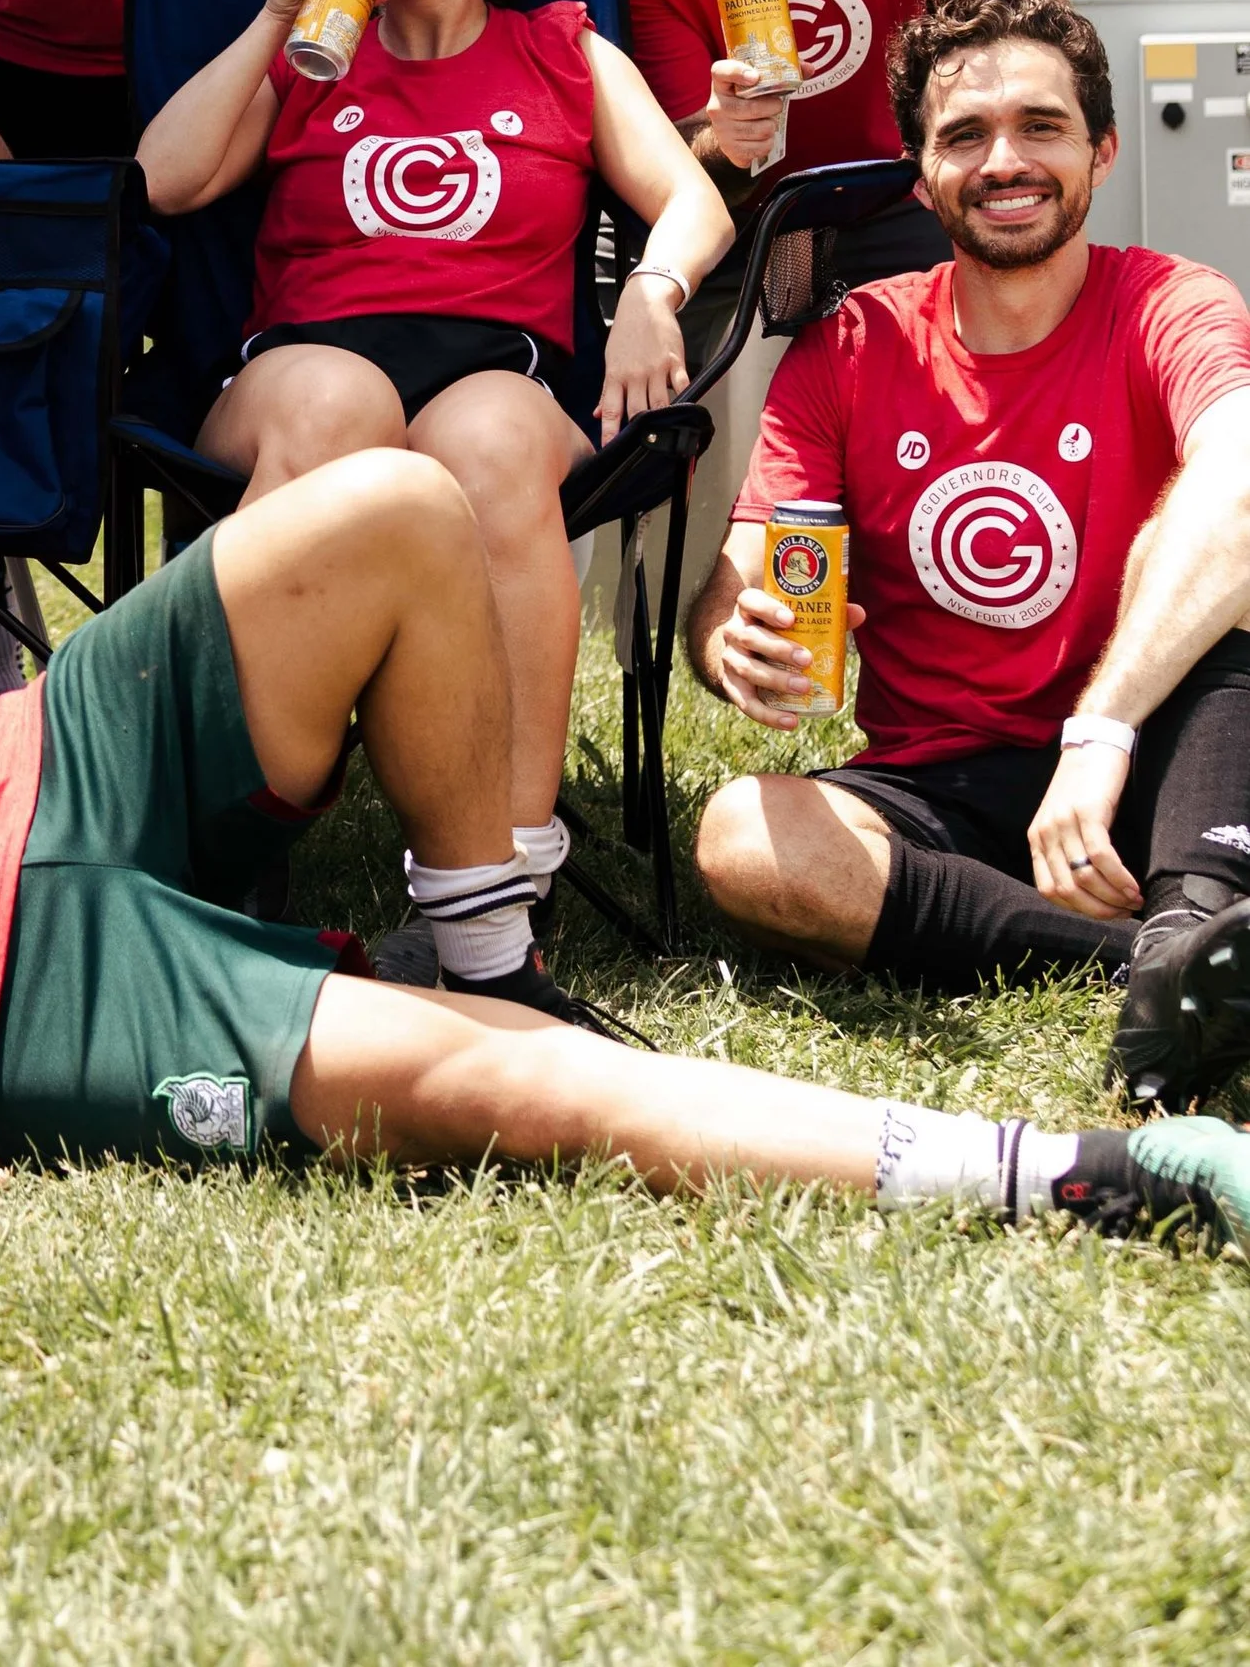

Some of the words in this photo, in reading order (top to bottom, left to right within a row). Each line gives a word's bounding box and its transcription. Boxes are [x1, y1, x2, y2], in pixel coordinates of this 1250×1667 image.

[797, 80, 826, 94] OOTY
[827, 62, 855, 84] 2026
[342, 112, 361, 127] JD
[900, 441, 926, 460] JD
[921, 468, 1022, 515] GOVERNORS
[1028, 483, 1055, 515] CUP
[774, 537, 826, 560] PAULANER
[777, 577, 821, 594] MÜNCHEN
[807, 617, 832, 625] LAGER
[947, 597, 971, 617] NYC
[975, 611, 1016, 624] FOOTY
[1019, 597, 1052, 621] 2026
